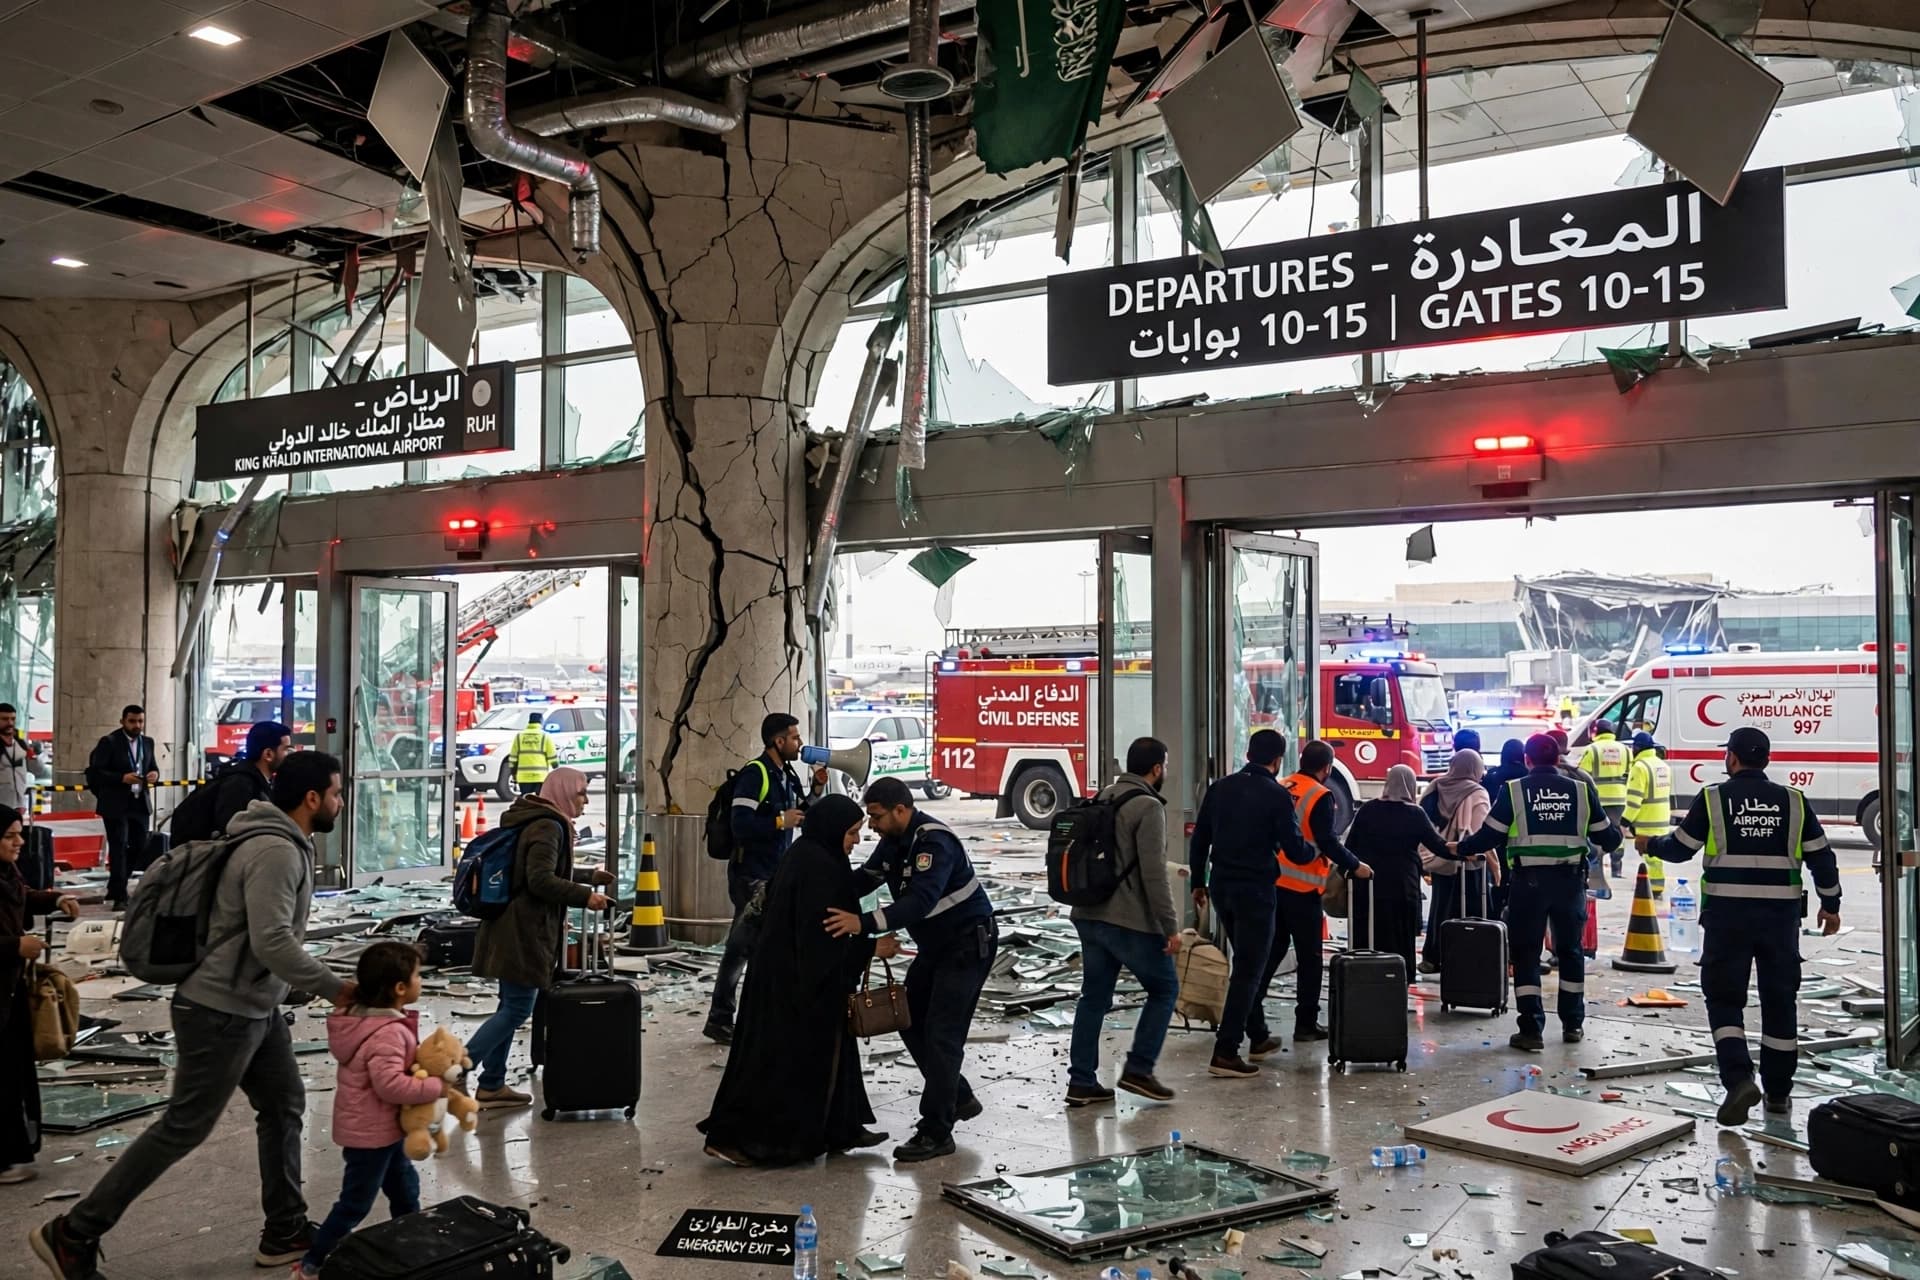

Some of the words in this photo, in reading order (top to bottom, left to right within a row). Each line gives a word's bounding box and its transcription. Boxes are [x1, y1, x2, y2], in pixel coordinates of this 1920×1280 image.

[1108, 251, 1355, 317] DEPARTURES
[1410, 191, 1701, 291] المغادرة
[1129, 317, 1241, 364] بوابات
[1260, 302, 1368, 347] 10-15
[1419, 279, 1563, 330] GATES
[1579, 261, 1706, 312] 10-15
[373, 374, 460, 418] الرياض
[317, 421, 352, 442] خالد
[355, 414, 401, 438] الملك
[404, 412, 446, 438] مطار
[466, 413, 496, 434] RUH
[268, 424, 314, 455] الدولي
[235, 456, 260, 472] KING
[262, 452, 301, 469] KHALID
[303, 443, 390, 465] INTERNATIONAL
[392, 435, 445, 455] AIRPORT
[978, 685, 1030, 710] المدني
[1033, 683, 1079, 709] الدفاع
[1736, 689, 1775, 705] السعودي
[1777, 688, 1806, 703] الأحمر
[1808, 689, 1836, 703] الهلال
[978, 711, 1014, 726] CIVIL
[1016, 711, 1080, 727] DEFENSE
[1742, 704, 1833, 718] AMBULANCE
[1793, 719, 1822, 735] 997
[941, 748, 976, 769] 112
[1789, 771, 1815, 786] 997
[1532, 802, 1572, 812] AIRPORT
[1538, 812, 1565, 821] STAFF
[1733, 815, 1783, 827] AIRPORT
[1740, 827, 1774, 838] STAFF
[689, 1215, 748, 1234] الطوارئ
[750, 1219, 789, 1238] مخرج
[676, 1238, 747, 1254] EMERGENCY
[748, 1242, 775, 1255] EXIT
